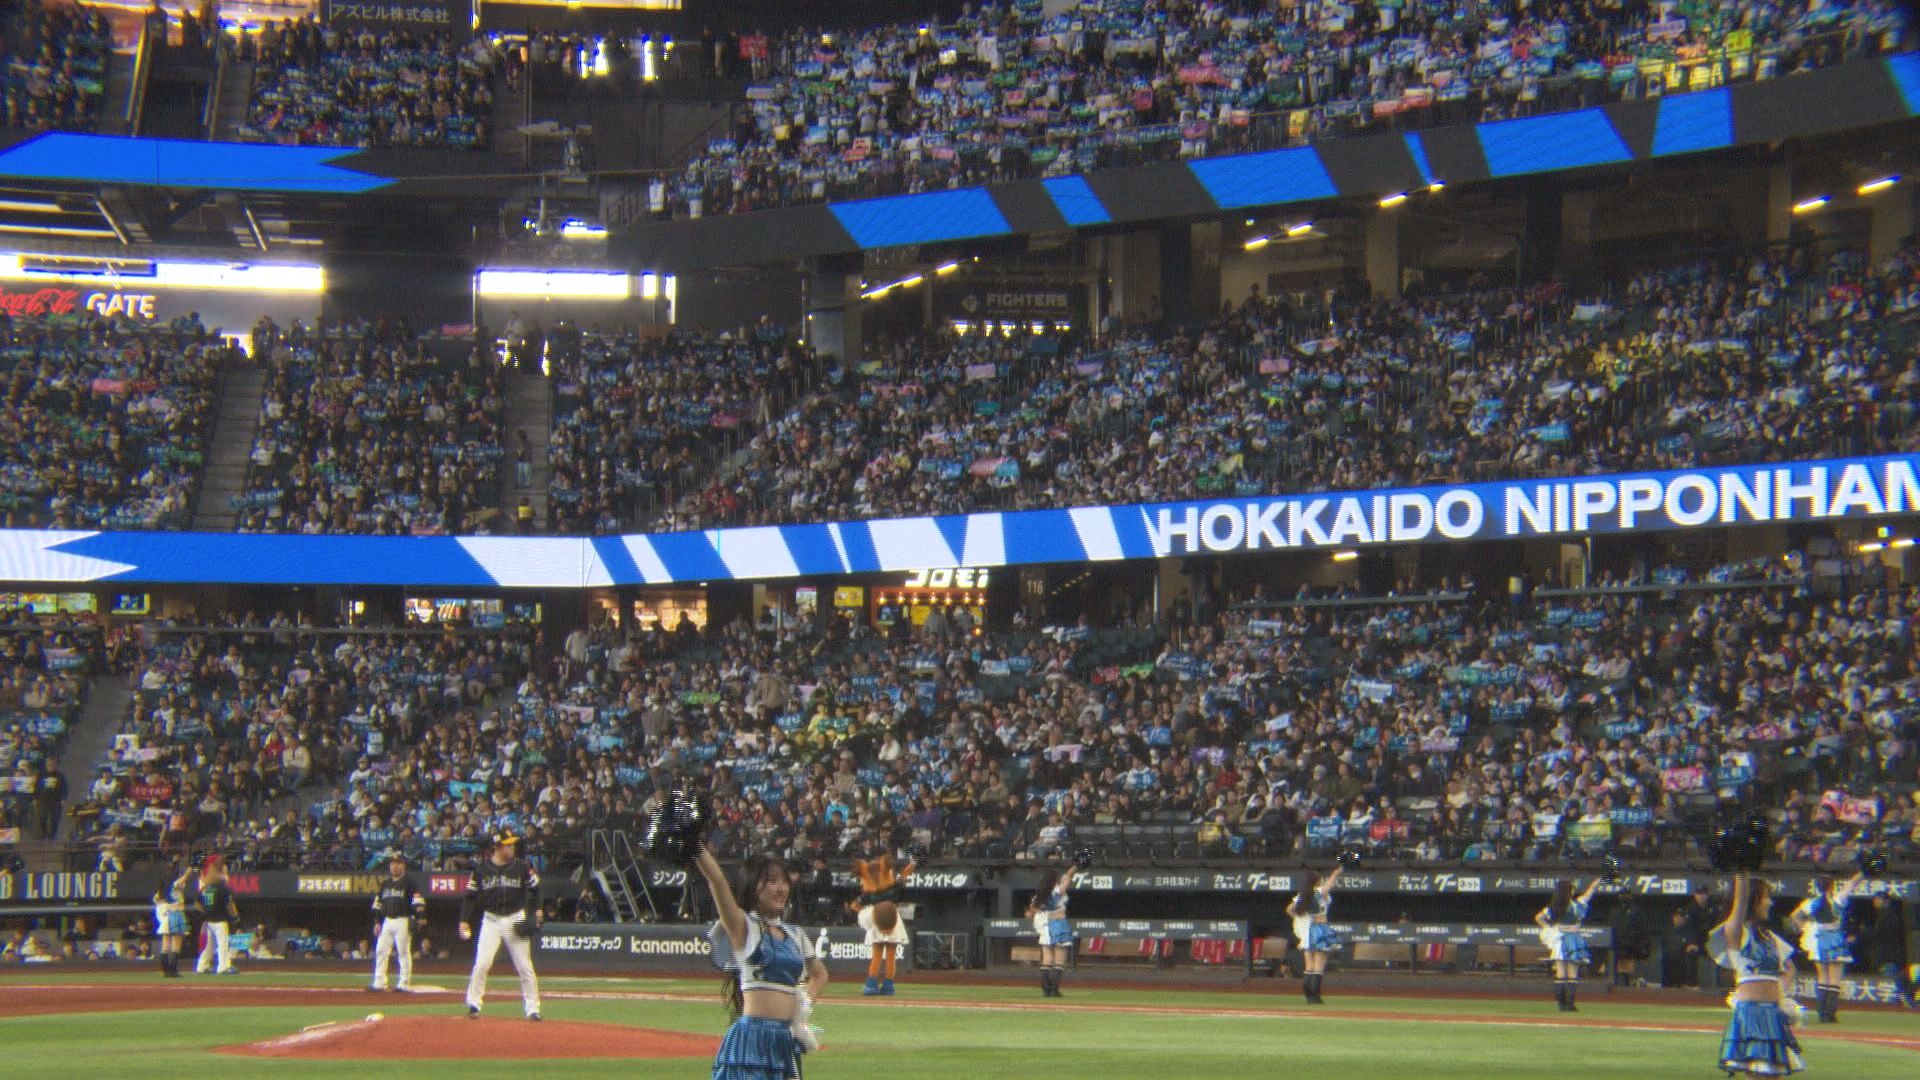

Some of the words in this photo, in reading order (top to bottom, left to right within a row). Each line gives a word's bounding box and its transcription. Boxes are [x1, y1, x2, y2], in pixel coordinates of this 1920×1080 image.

[332, 4, 449, 23] アズビル株式会社
[87, 292, 156, 319] GATE
[987, 293, 1067, 307] FIGHTERS
[1158, 488, 1484, 553] HOKKAIDO
[1027, 579, 1044, 595] 116
[26, 872, 119, 899] LOUNGE
